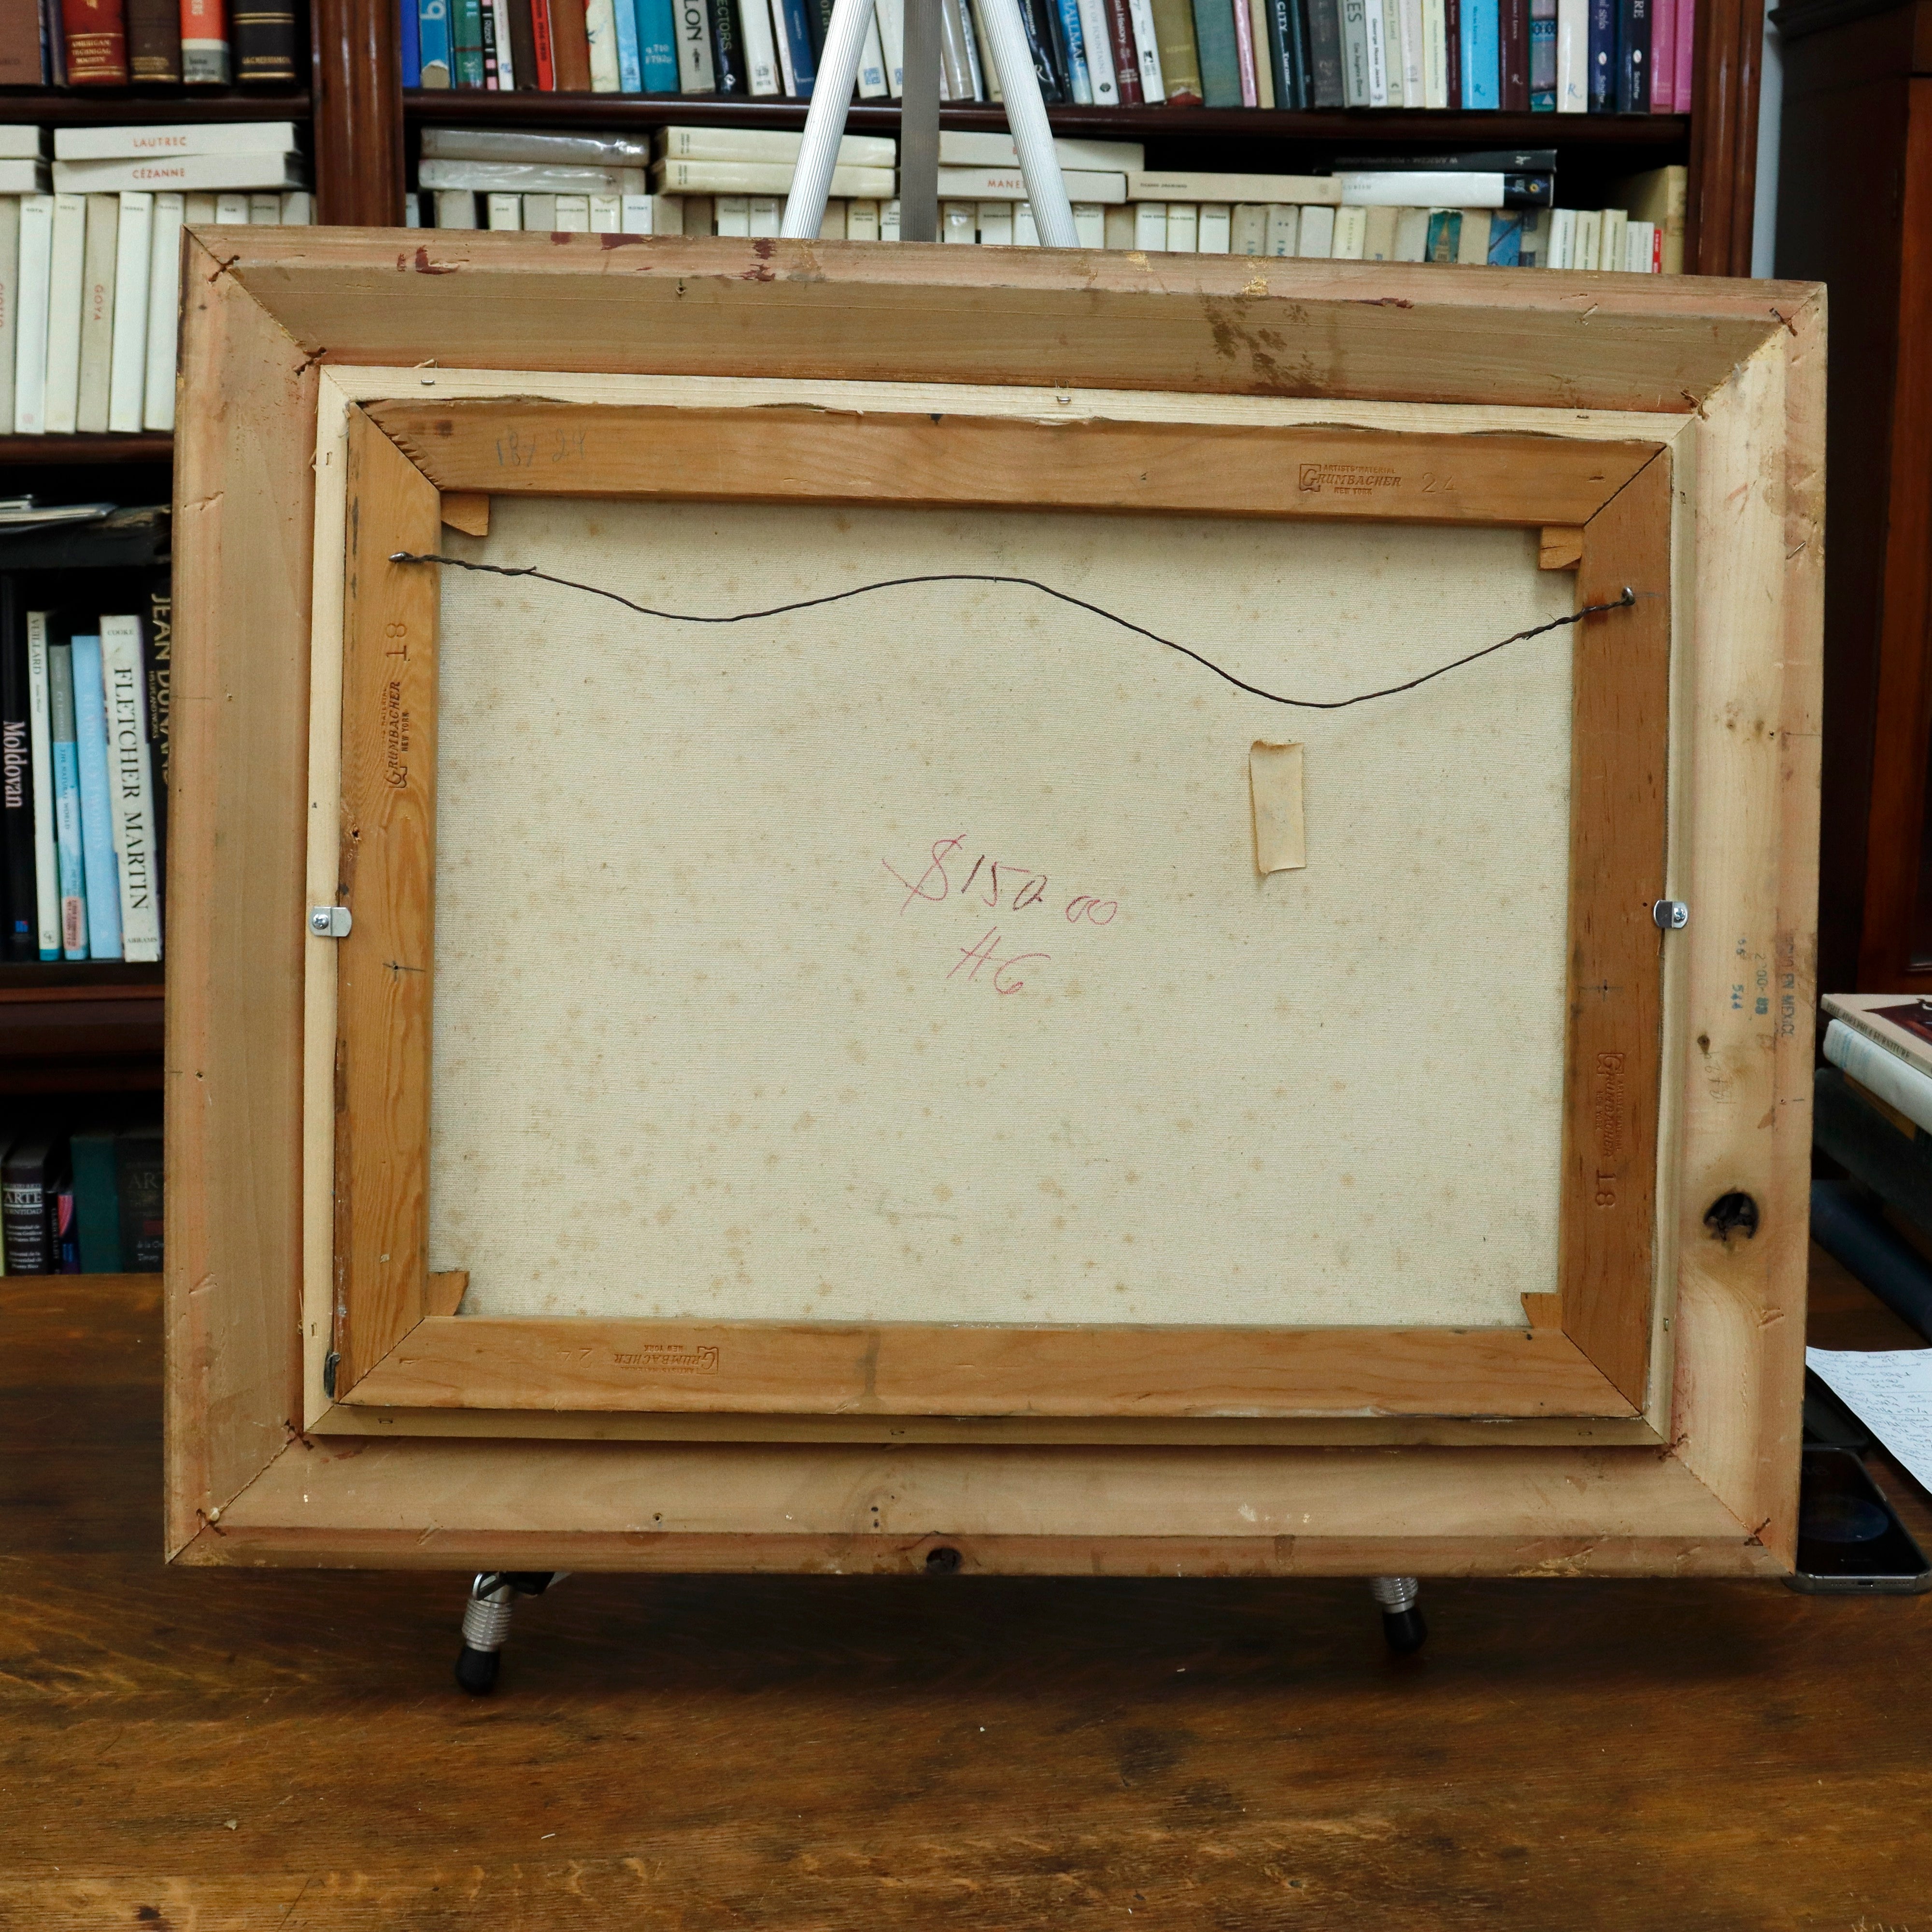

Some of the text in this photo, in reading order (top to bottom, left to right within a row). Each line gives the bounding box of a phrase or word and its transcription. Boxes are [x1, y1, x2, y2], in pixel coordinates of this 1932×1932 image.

[1117, 13, 1127, 43] History
[1277, 1, 1287, 32] CITY
[72, 40, 111, 48] AMERICAN
[75, 56, 105, 64] SOCIETY
[133, 137, 187, 147] LAUTREC
[132, 168, 185, 179] CÉZANNE
[94, 285, 104, 320] GOYA
[1303, 469, 1402, 487] GRUMBACHER
[1353, 487, 1373, 496] YORK
[151, 593, 171, 661] JEAN
[30, 618, 42, 675] VUILLARD
[386, 623, 408, 785] GRUMBACHER 18
[3, 721, 28, 809] Moldovan
[114, 668, 149, 910] FLETCHER MARTIN
[1827, 1002, 1910, 1058] PHILADELPHIA FURNITURE
[1595, 1055, 1622, 1207] GRUMBACHER 18
[4, 1192, 42, 1204] ARTE
[613, 1352, 716, 1370] GRUMBACHER
